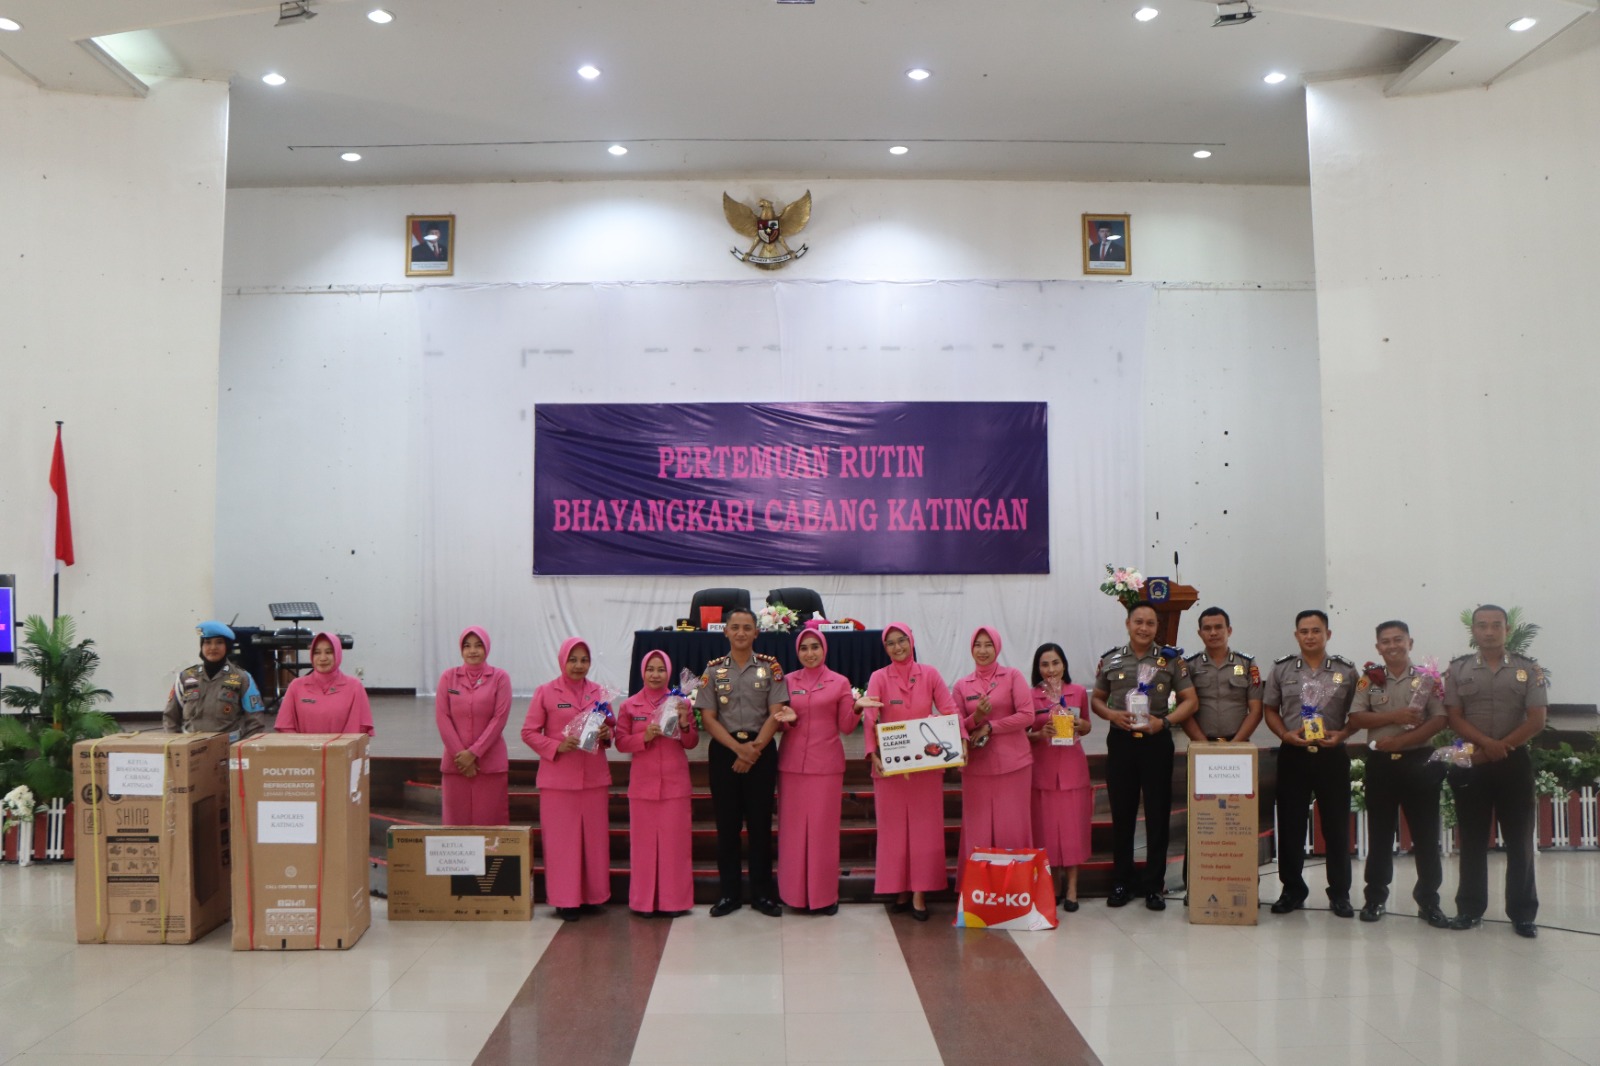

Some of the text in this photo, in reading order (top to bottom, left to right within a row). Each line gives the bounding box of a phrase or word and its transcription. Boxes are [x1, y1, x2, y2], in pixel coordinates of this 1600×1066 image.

[658, 445, 925, 479] PERTEMUAN RUTIN
[553, 498, 1029, 532] BHAYANGKARI CABANG KATINGAN
[882, 733, 908, 741] VACUUM
[882, 739, 911, 747] CLEANER
